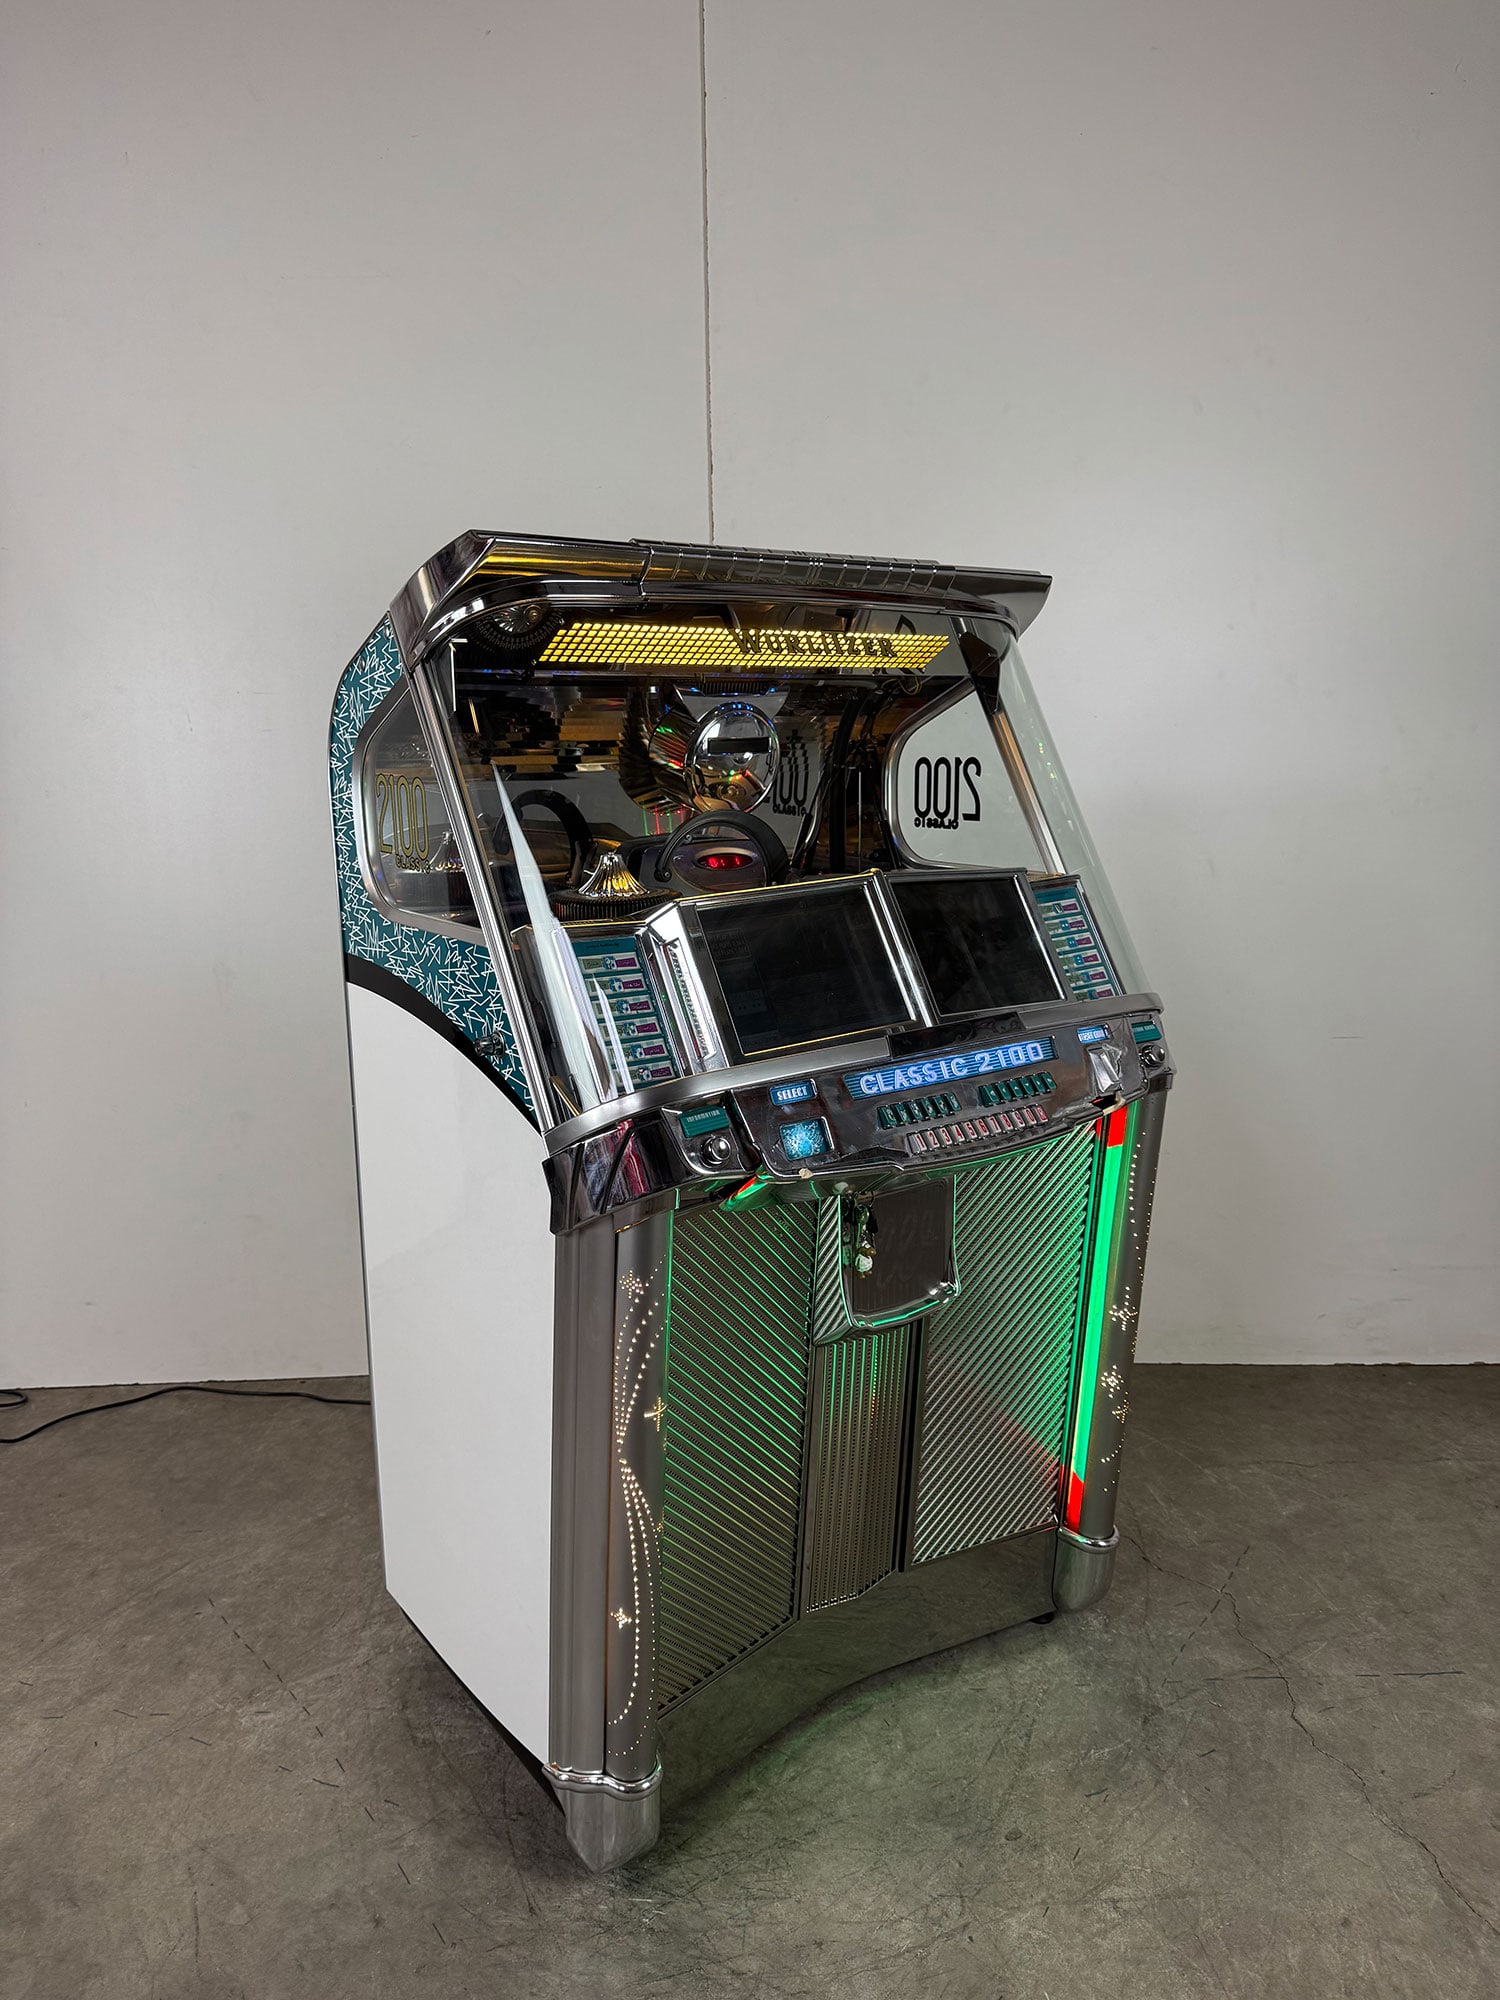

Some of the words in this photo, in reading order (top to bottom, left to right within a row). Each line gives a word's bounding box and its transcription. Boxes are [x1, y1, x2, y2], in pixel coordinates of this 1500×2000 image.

[729, 628, 897, 657] WURLITZER
[376, 773, 429, 860] 2100
[396, 855, 430, 874] CLASSIC
[860, 1058, 968, 1095] CLASSIC
[974, 1042, 1044, 1073] 2100
[776, 1085, 808, 1101] SELECT
[916, 1134, 925, 1148] 1
[929, 1132, 938, 1146] 2
[942, 1130, 951, 1144] 3
[955, 1126, 964, 1141] 4
[966, 1123, 976, 1137] 5
[978, 1120, 988, 1134] 6
[990, 1117, 1000, 1131] 7
[1001, 1115, 1011, 1128] 8
[1014, 1112, 1024, 1126] 9
